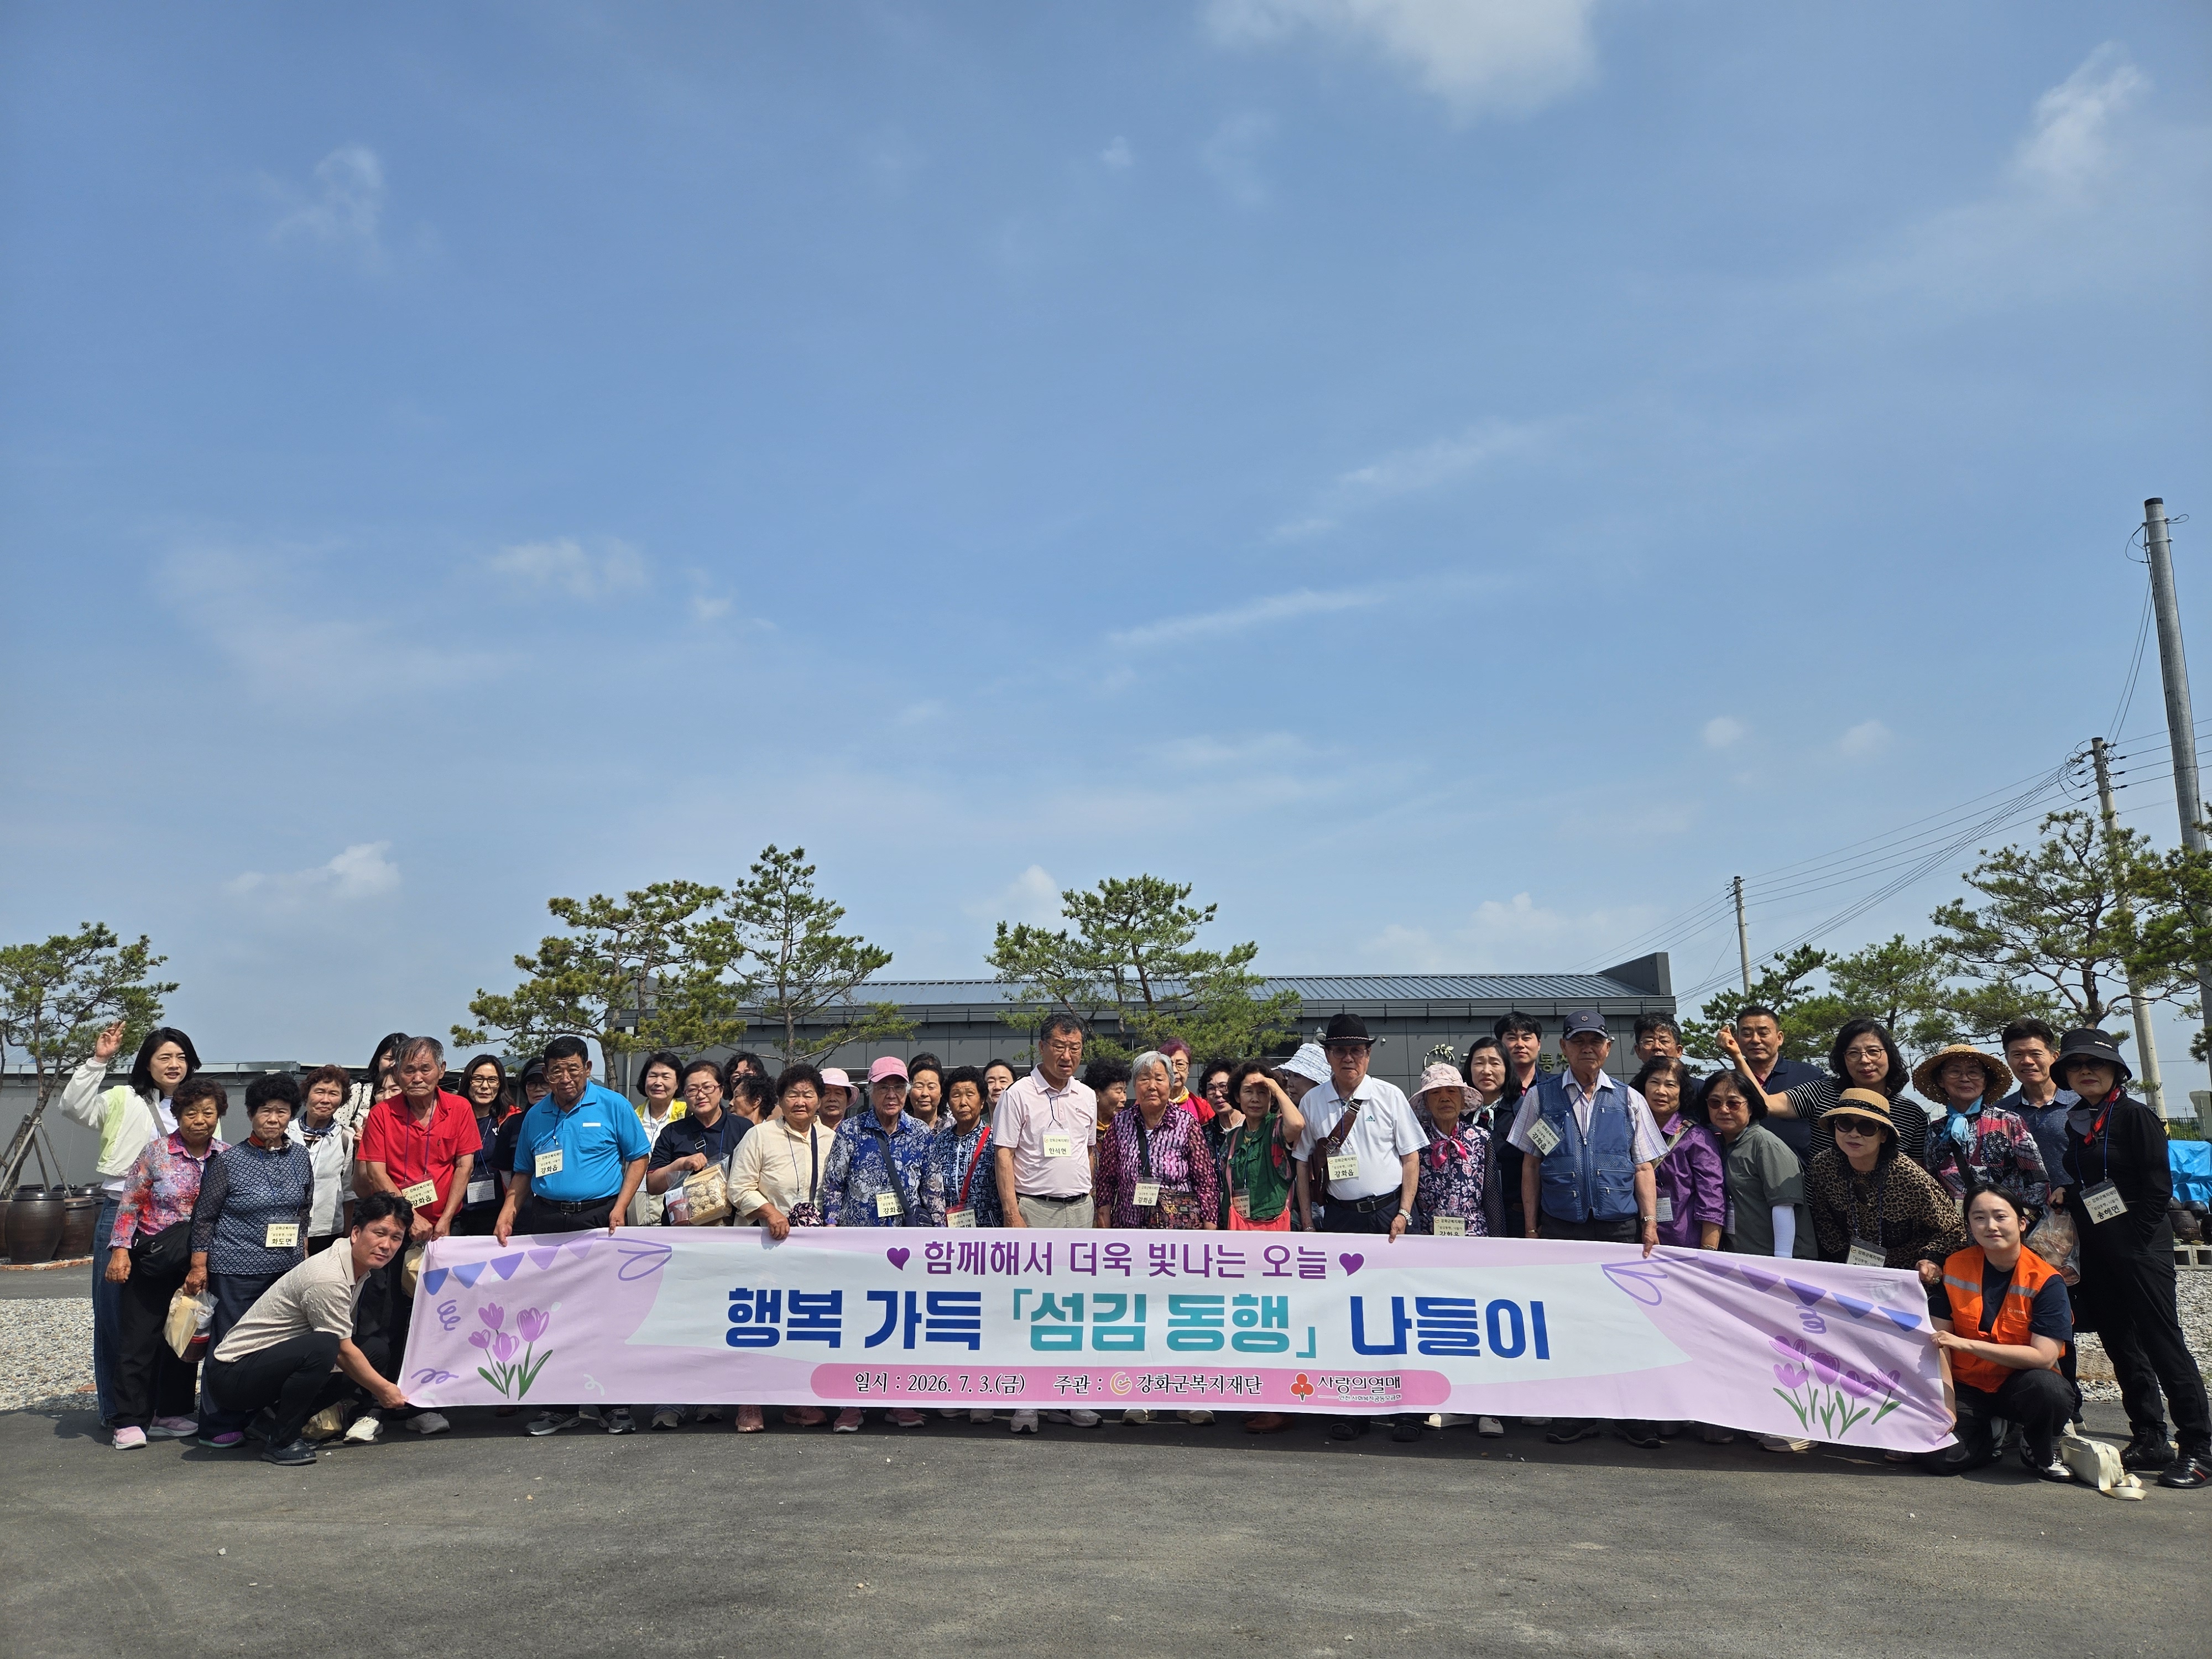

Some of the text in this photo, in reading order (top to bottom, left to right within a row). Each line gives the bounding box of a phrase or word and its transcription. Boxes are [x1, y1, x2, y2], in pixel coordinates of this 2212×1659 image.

[1532, 1132, 1547, 1150] 강화읍
[540, 1164, 558, 1174] 강화읍
[1334, 1169, 1354, 1178] 강화읍
[411, 1195, 432, 1206] 강화읍
[883, 1206, 902, 1214] 강화읍
[924, 1241, 1328, 1280] 함께해서 더욱 빛나는 오늘
[726, 1288, 1551, 1360] 행복 가득 「섬김 동행」 나들이
[855, 1372, 888, 1394] 일시
[908, 1374, 952, 1394] 2026.
[959, 1375, 973, 1394] 7.
[1054, 1375, 1091, 1395] 주관
[1137, 1374, 1262, 1395] 강화군복지재단
[1318, 1376, 1401, 1394] 사랑의열매
